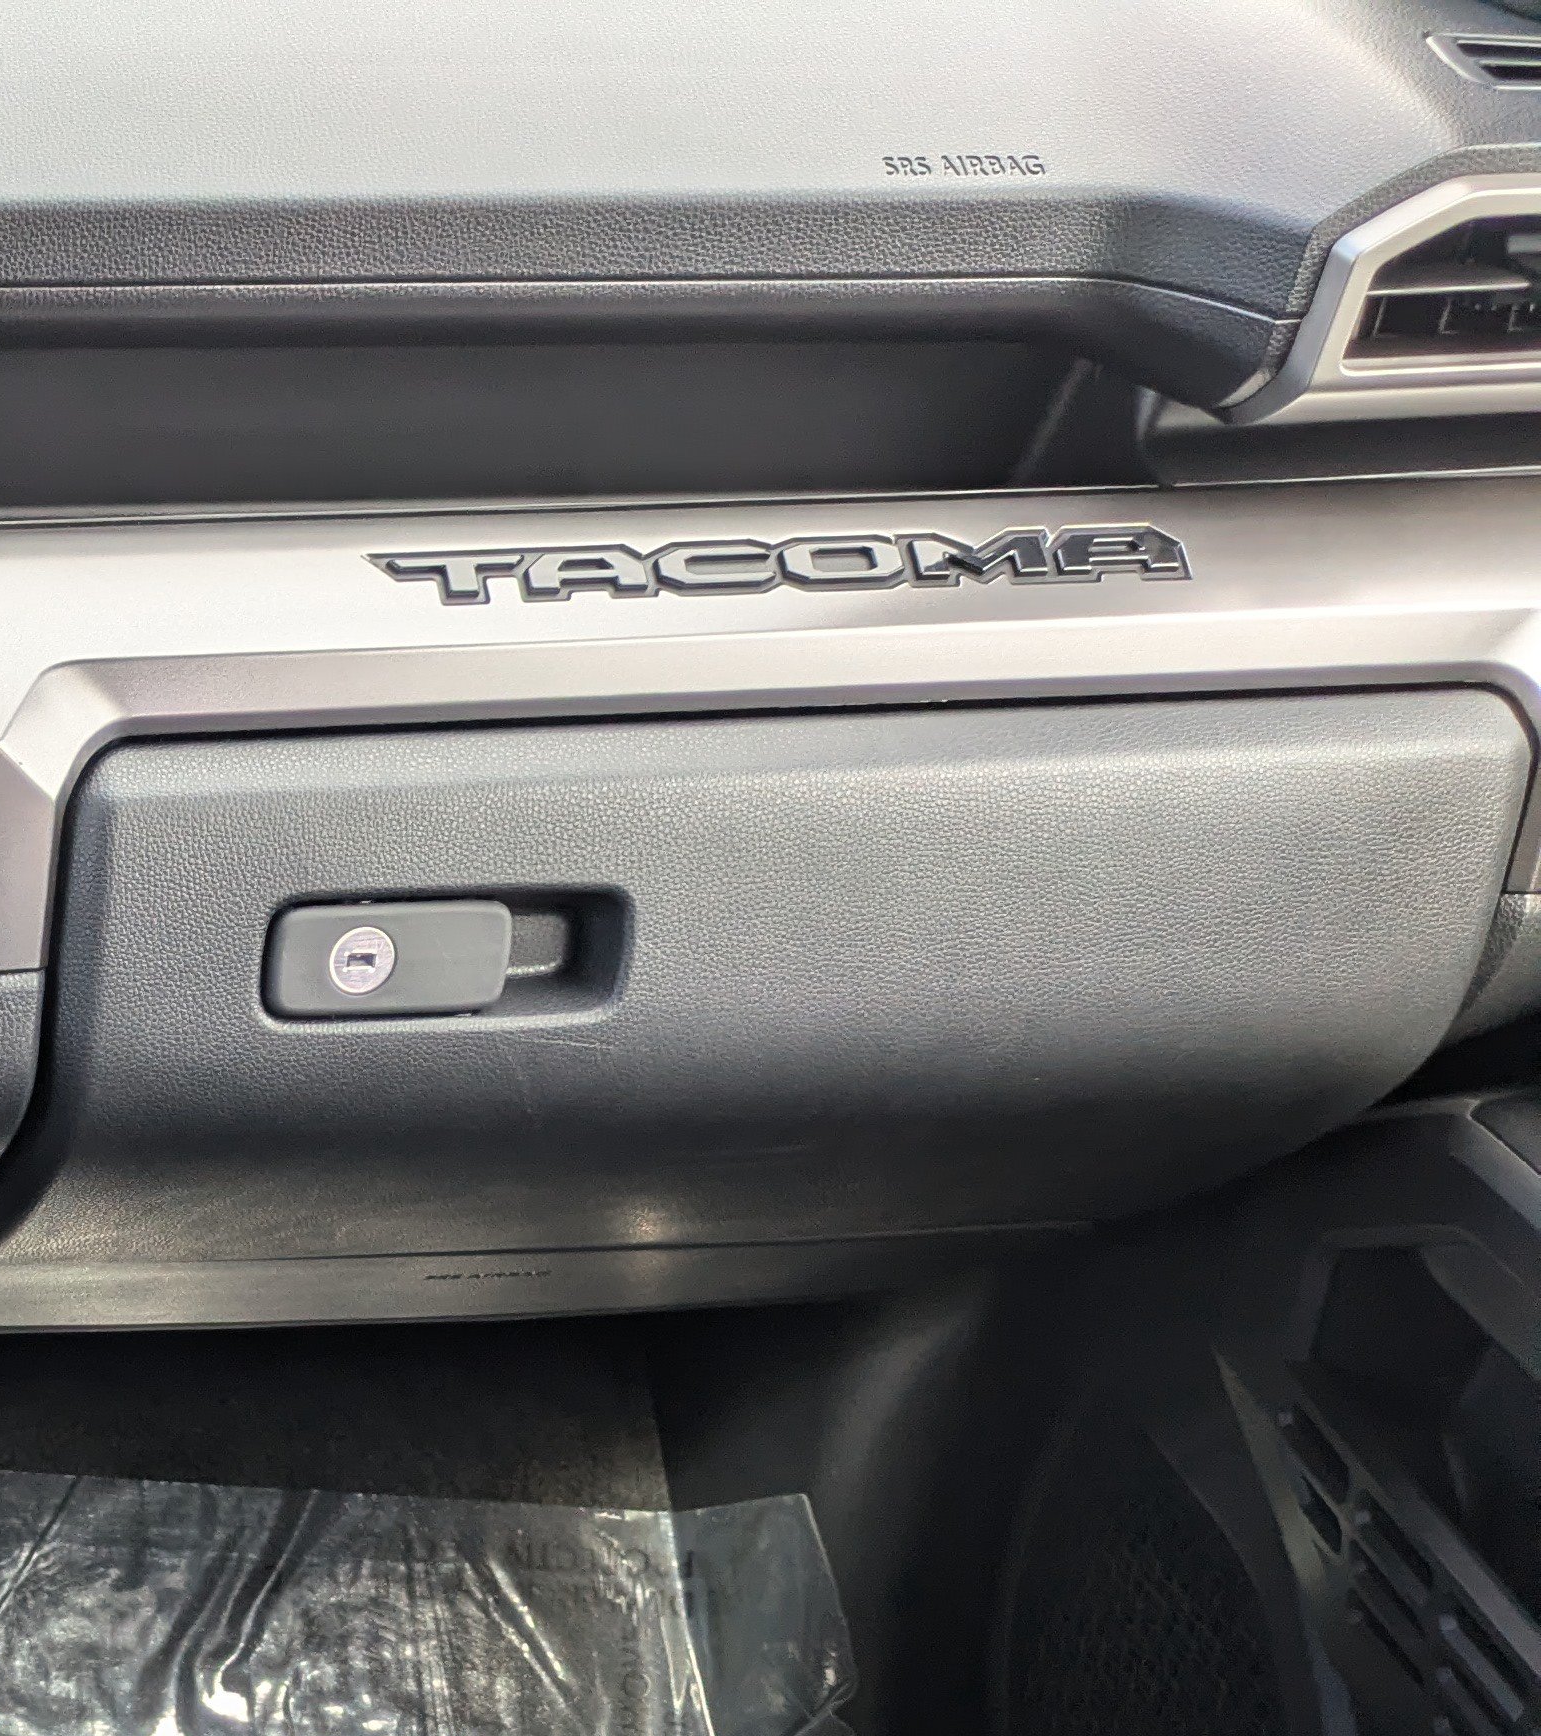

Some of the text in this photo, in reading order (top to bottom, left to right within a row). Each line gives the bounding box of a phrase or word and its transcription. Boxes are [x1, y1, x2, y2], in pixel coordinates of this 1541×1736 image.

[882, 155, 1046, 176] SRS AIRBAG
[361, 524, 1193, 606] TACOMA
